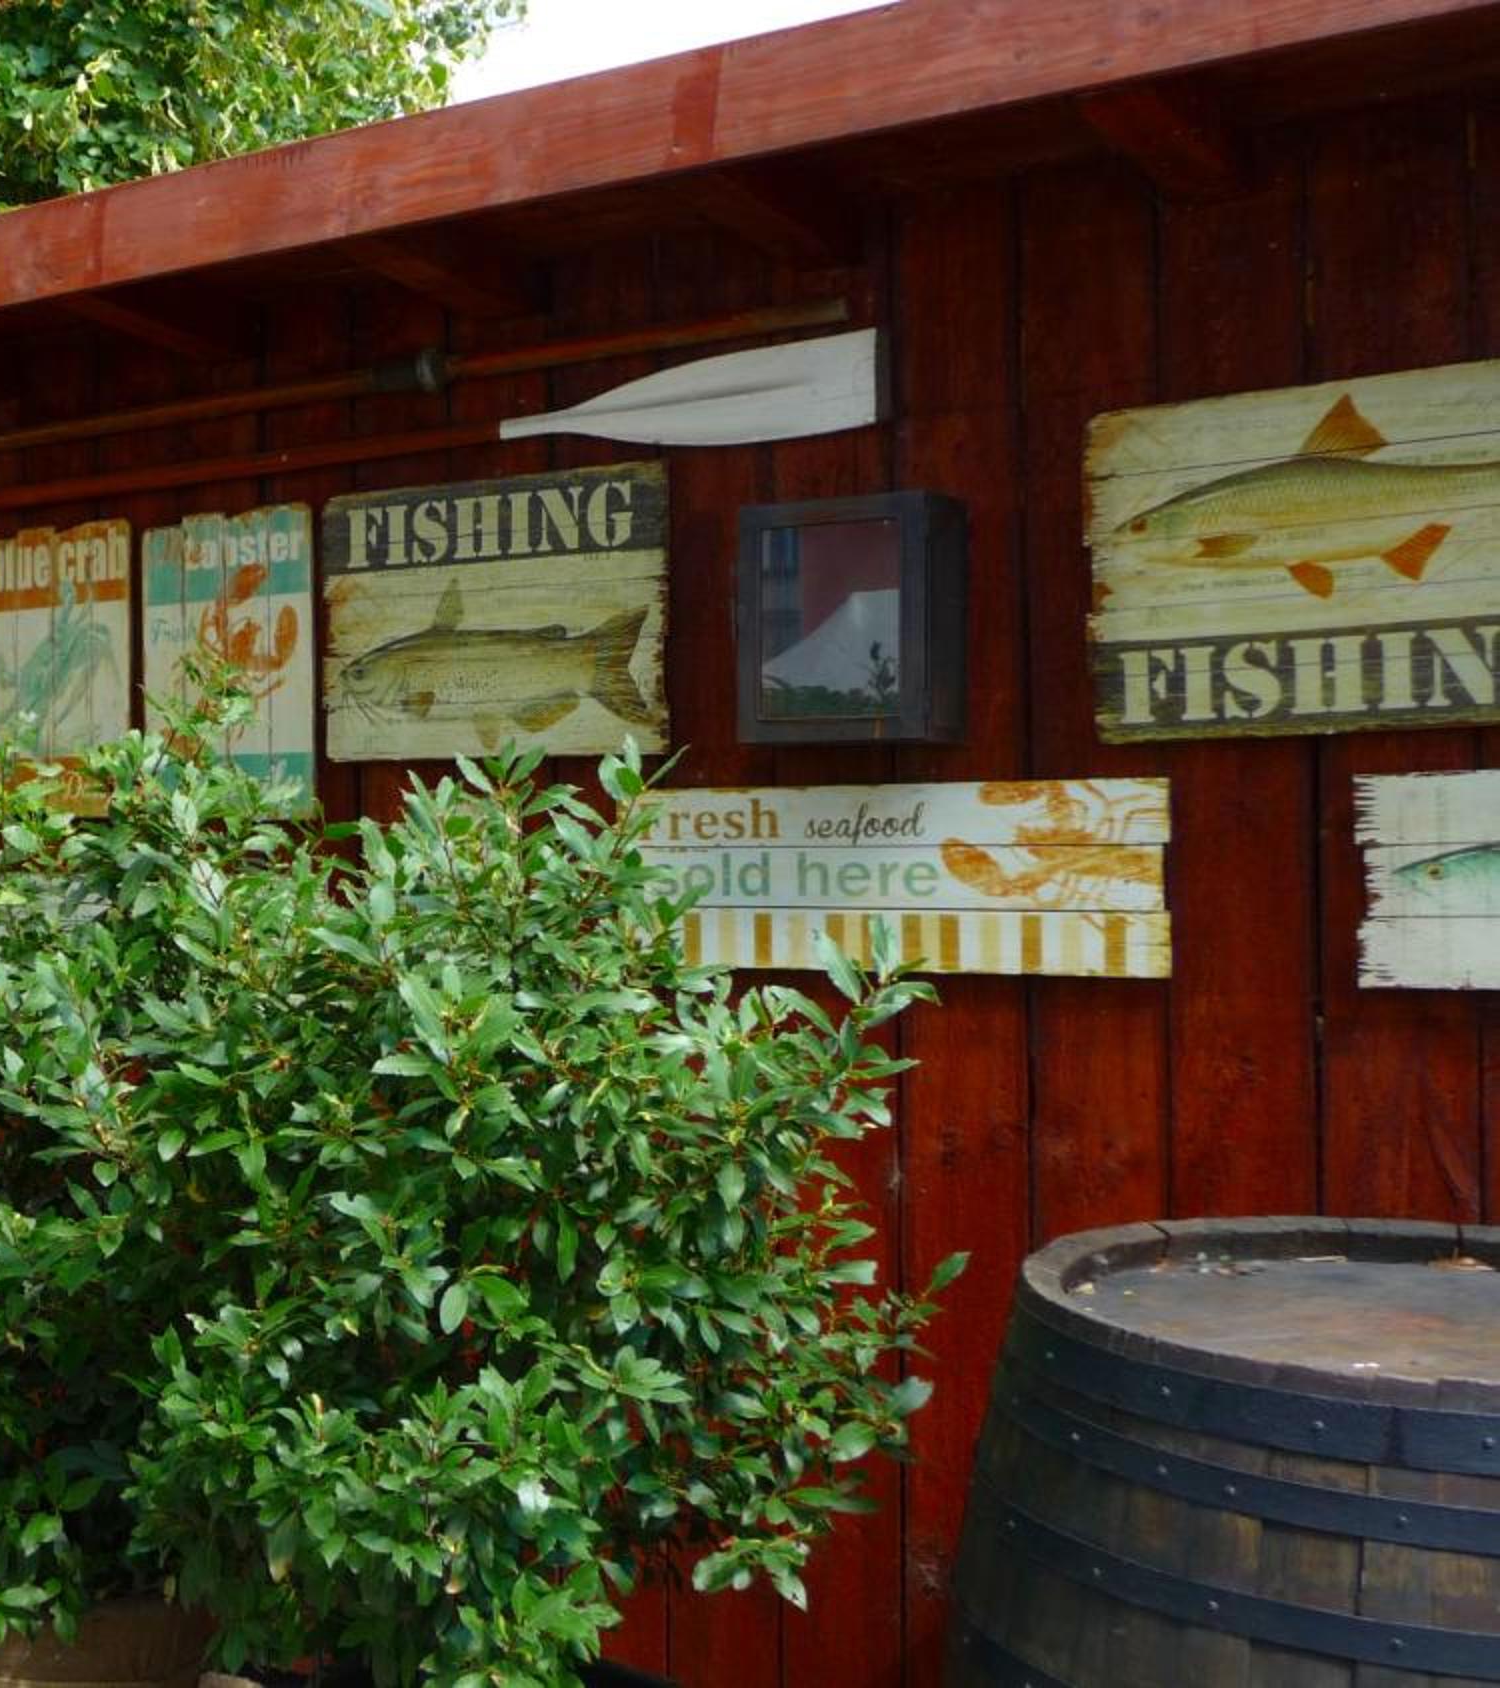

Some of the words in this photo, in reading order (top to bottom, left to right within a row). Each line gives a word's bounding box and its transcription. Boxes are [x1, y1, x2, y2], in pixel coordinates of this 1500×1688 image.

[346, 480, 634, 568] FISHING
[59, 527, 127, 584] crab
[1120, 624, 1500, 724] FISHIN
[804, 802, 924, 846] seafood
[652, 851, 770, 897] sold
[798, 851, 940, 896] here
